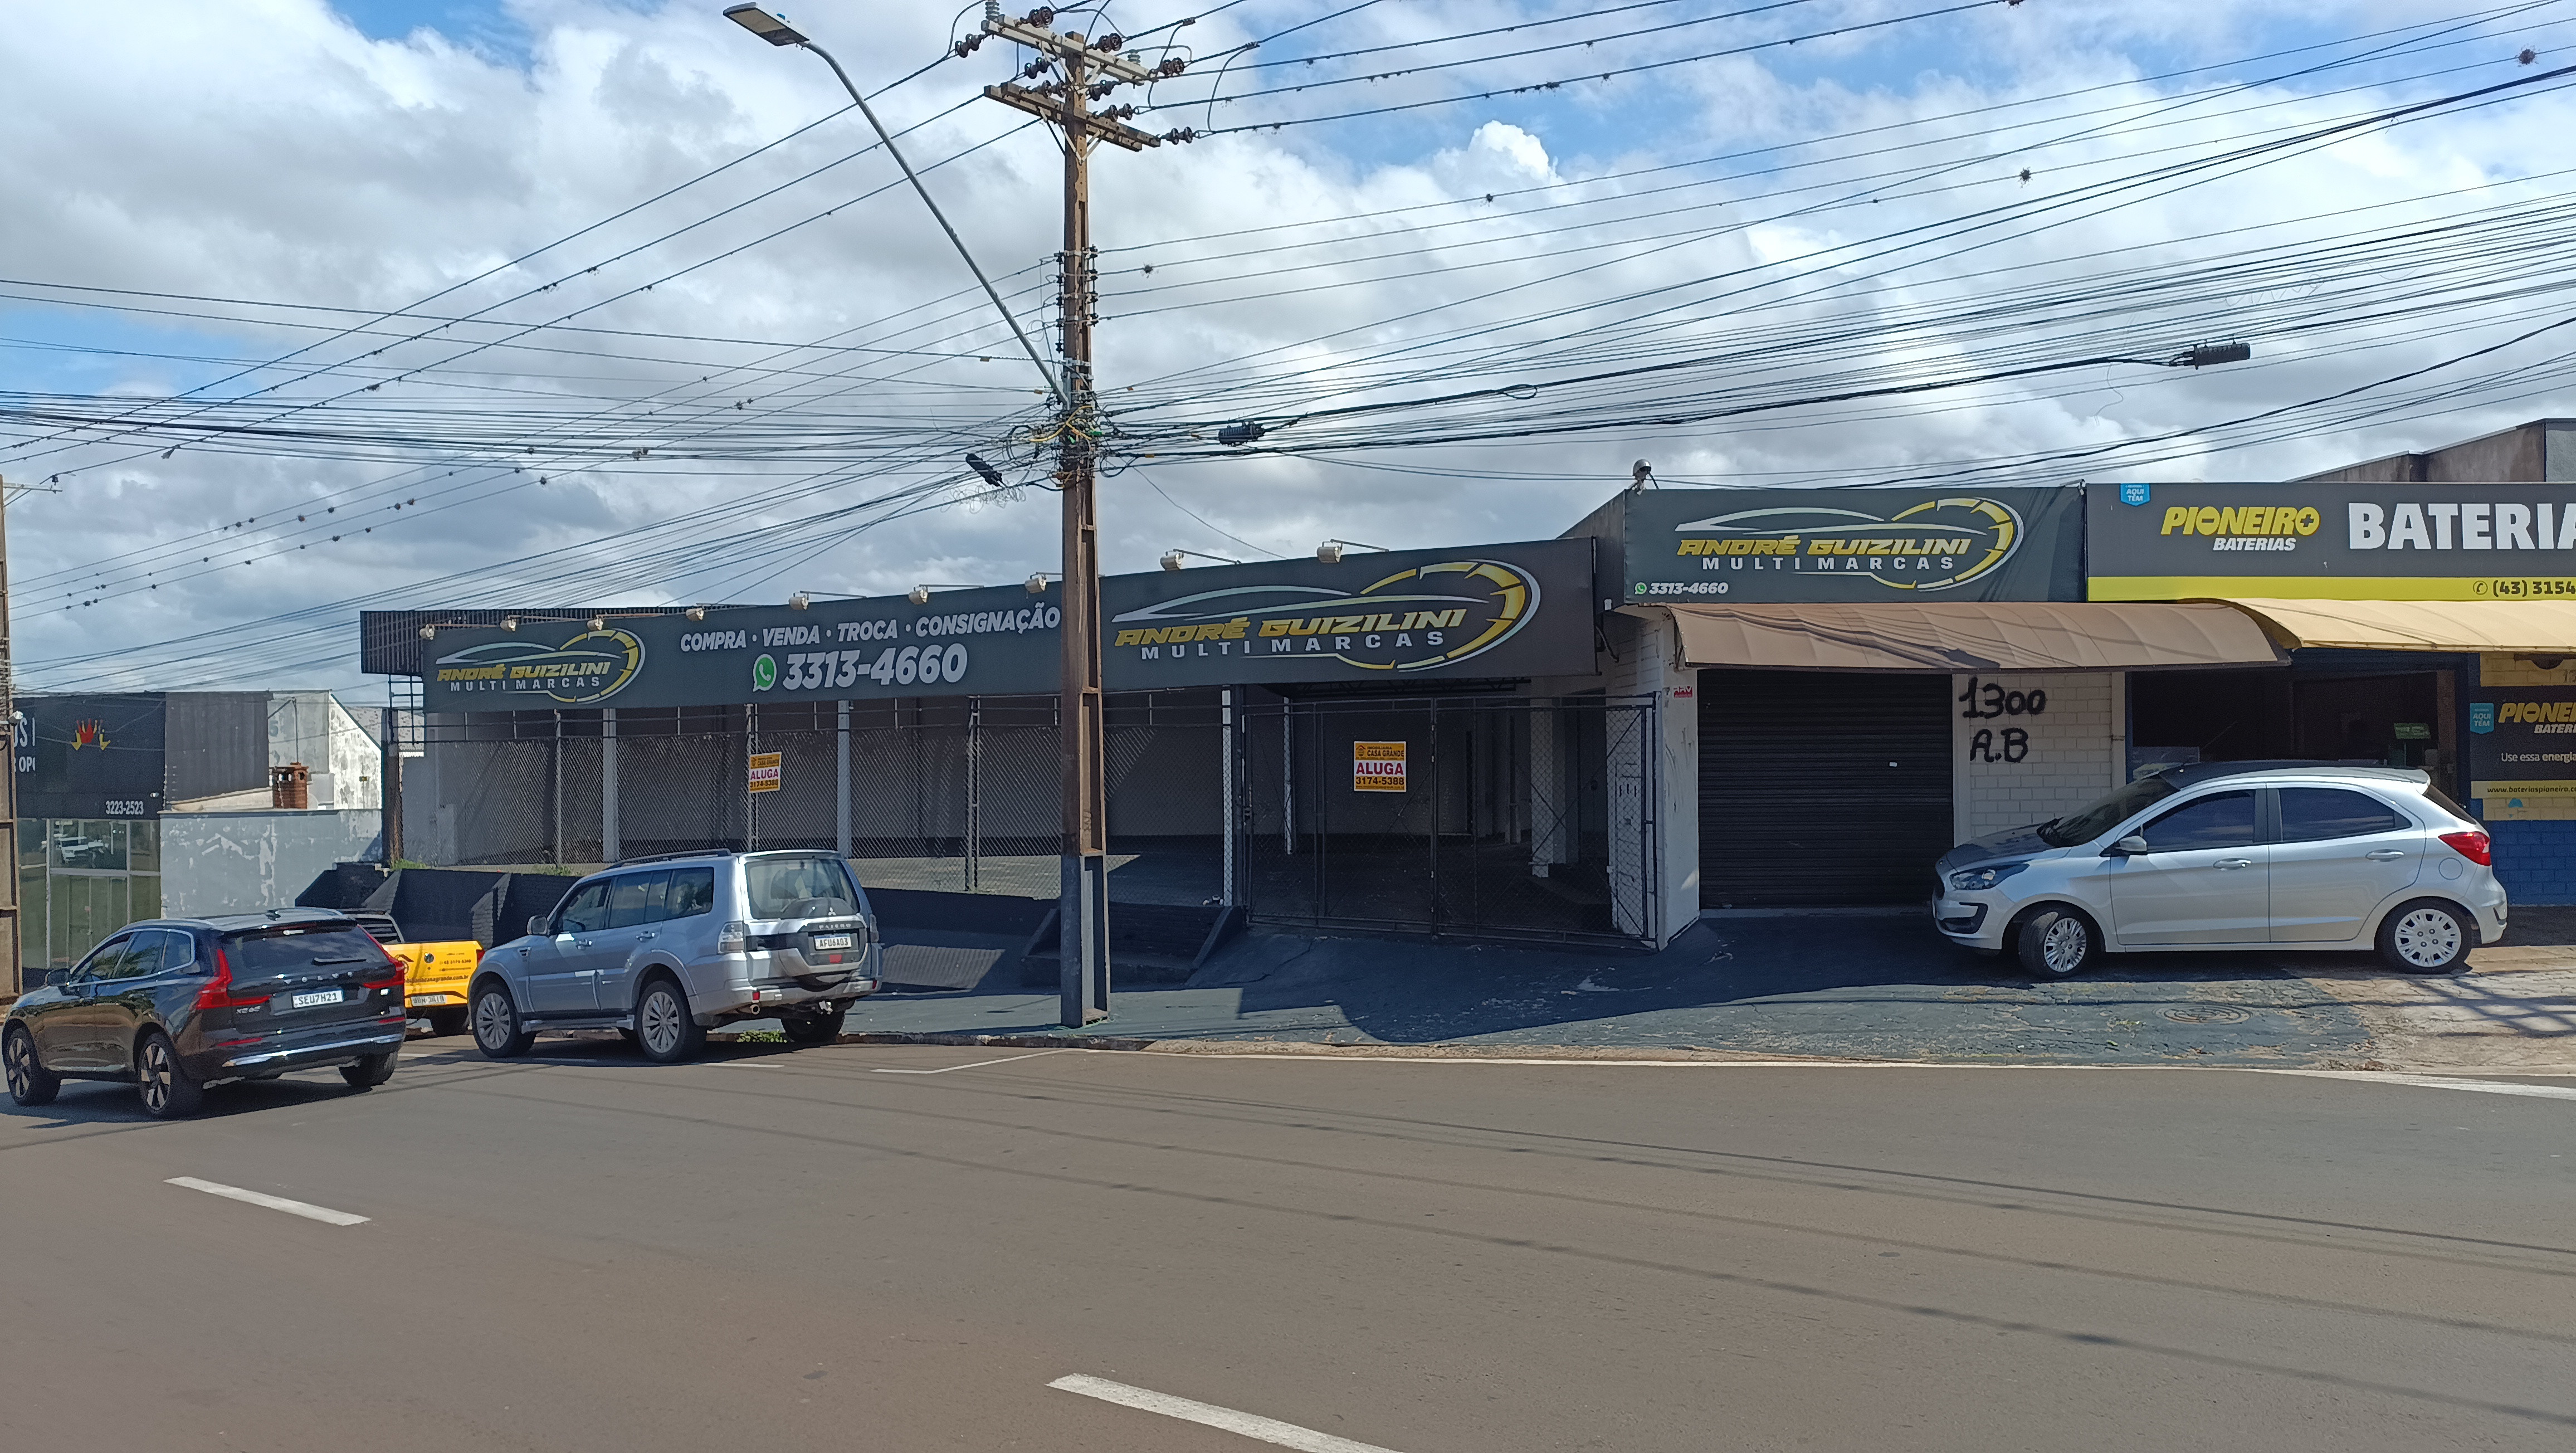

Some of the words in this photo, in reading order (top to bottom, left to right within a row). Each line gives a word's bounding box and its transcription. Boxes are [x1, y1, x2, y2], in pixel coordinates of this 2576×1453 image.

[2161, 506, 2320, 535] PIONEIRO
[1677, 535, 1800, 555] ANDRÉ
[1807, 538, 1972, 555] GUIZILINI
[2213, 538, 2296, 551] BATERIAS
[1649, 582, 1729, 594] 3313-4660
[2493, 579, 2528, 598] (43)
[2533, 581, 2576, 594] 3154
[680, 629, 747, 652] COMPRA
[762, 625, 821, 647] VENDA
[837, 620, 898, 642] TROCA
[915, 602, 1060, 637] CONSIGNAÇÃO
[1114, 617, 1251, 647] ANDRÉ
[1257, 609, 1467, 637] GUIZILINI
[437, 664, 505, 681] ANDRÉ
[509, 661, 611, 679] GUIZILINI
[782, 643, 968, 690] 3313-4660
[2501, 753, 2518, 762] Use
[2542, 752, 2576, 763] energia
[750, 769, 778, 780] ALUGA
[1356, 762, 1403, 774] ALUGA
[1355, 777, 1404, 785] 3174-5388
[105, 801, 144, 815] 3223-2523
[298, 992, 338, 1006] SEU7H21
